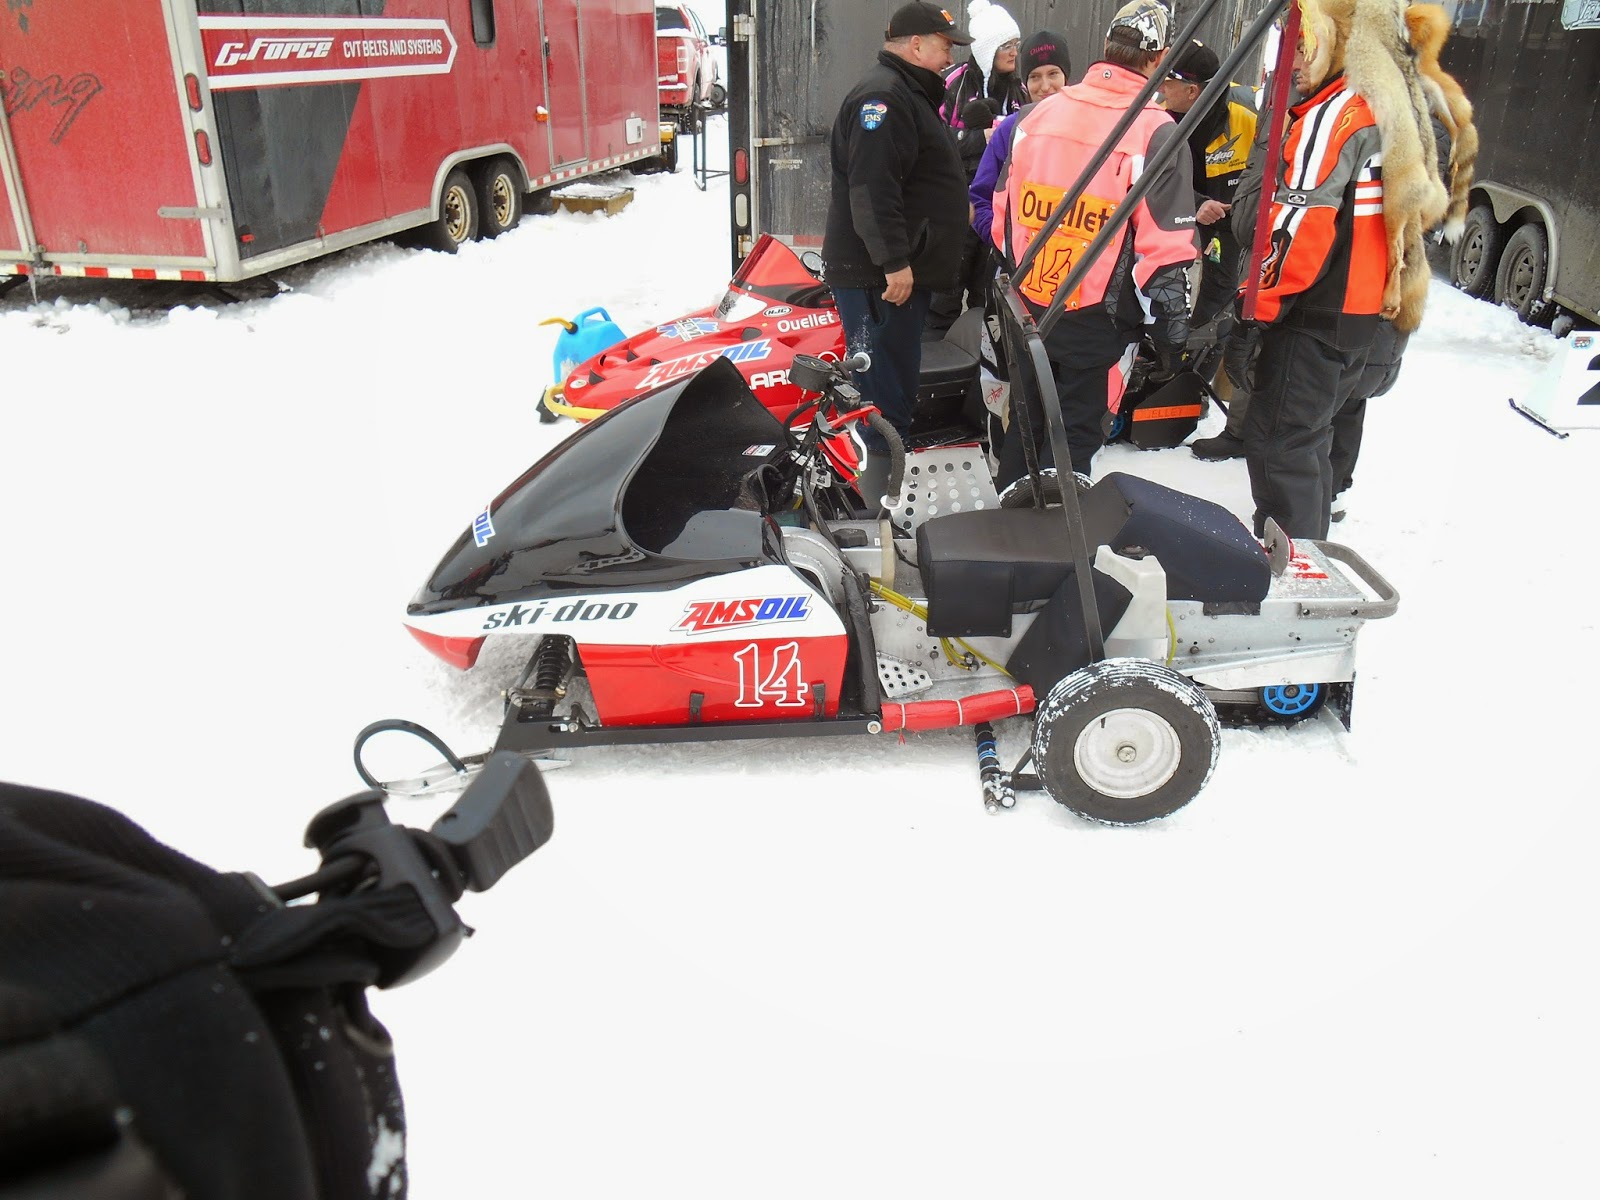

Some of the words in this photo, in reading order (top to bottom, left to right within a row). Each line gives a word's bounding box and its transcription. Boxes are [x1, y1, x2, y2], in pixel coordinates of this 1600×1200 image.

[343, 40, 361, 58] CVT
[362, 40, 388, 57] BELTS
[390, 39, 407, 56] AND
[407, 38, 443, 55] SYSTEMS
[864, 114, 881, 122] EMS
[1022, 190, 1110, 233] Oullet
[777, 310, 836, 333] Ouellet
[482, 600, 638, 630] ski-doo
[678, 596, 810, 633] AMSOIL
[733, 642, 808, 707] 14
